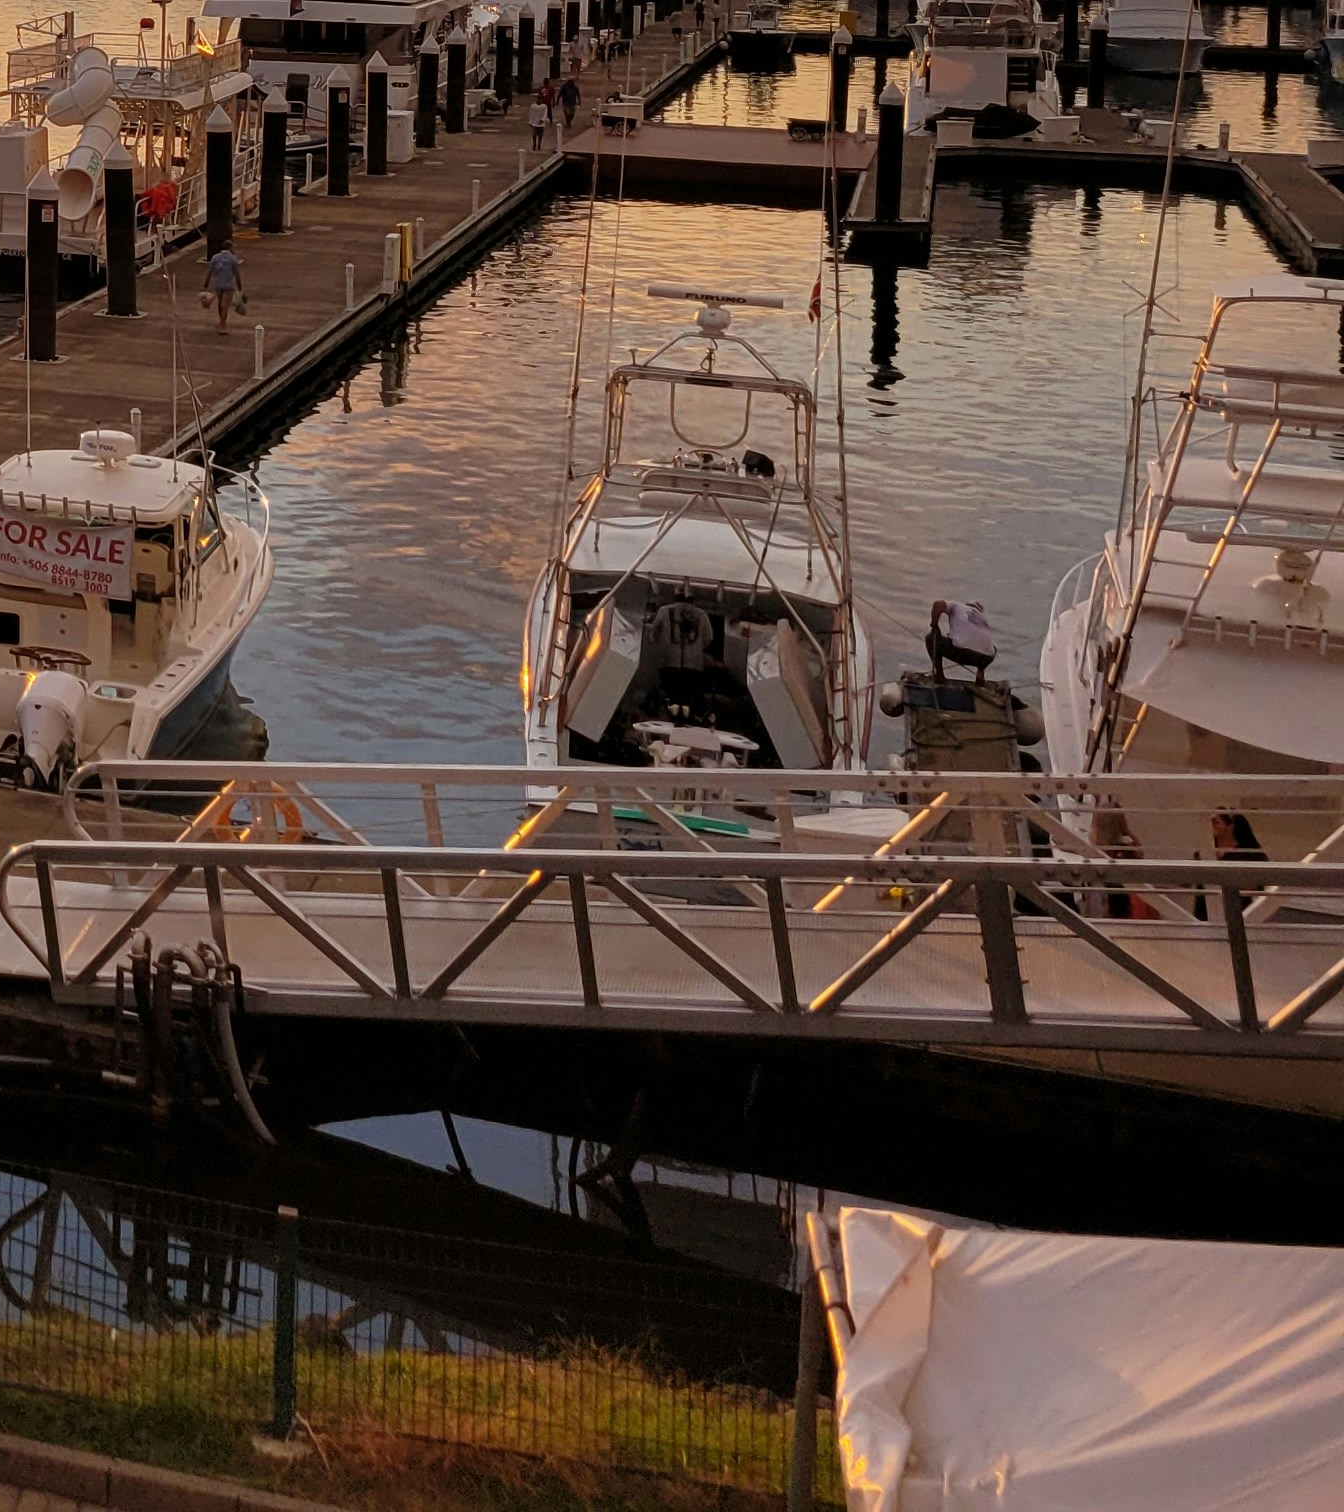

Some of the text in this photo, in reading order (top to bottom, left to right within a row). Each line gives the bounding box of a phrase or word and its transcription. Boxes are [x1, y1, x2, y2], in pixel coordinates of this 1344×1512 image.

[685, 292, 747, 304] FURUNO
[54, 531, 126, 564] SALE
[23, 558, 49, 572] +506
[51, 563, 112, 583] 8844-8780
[51, 574, 109, 595] 8519 3003
